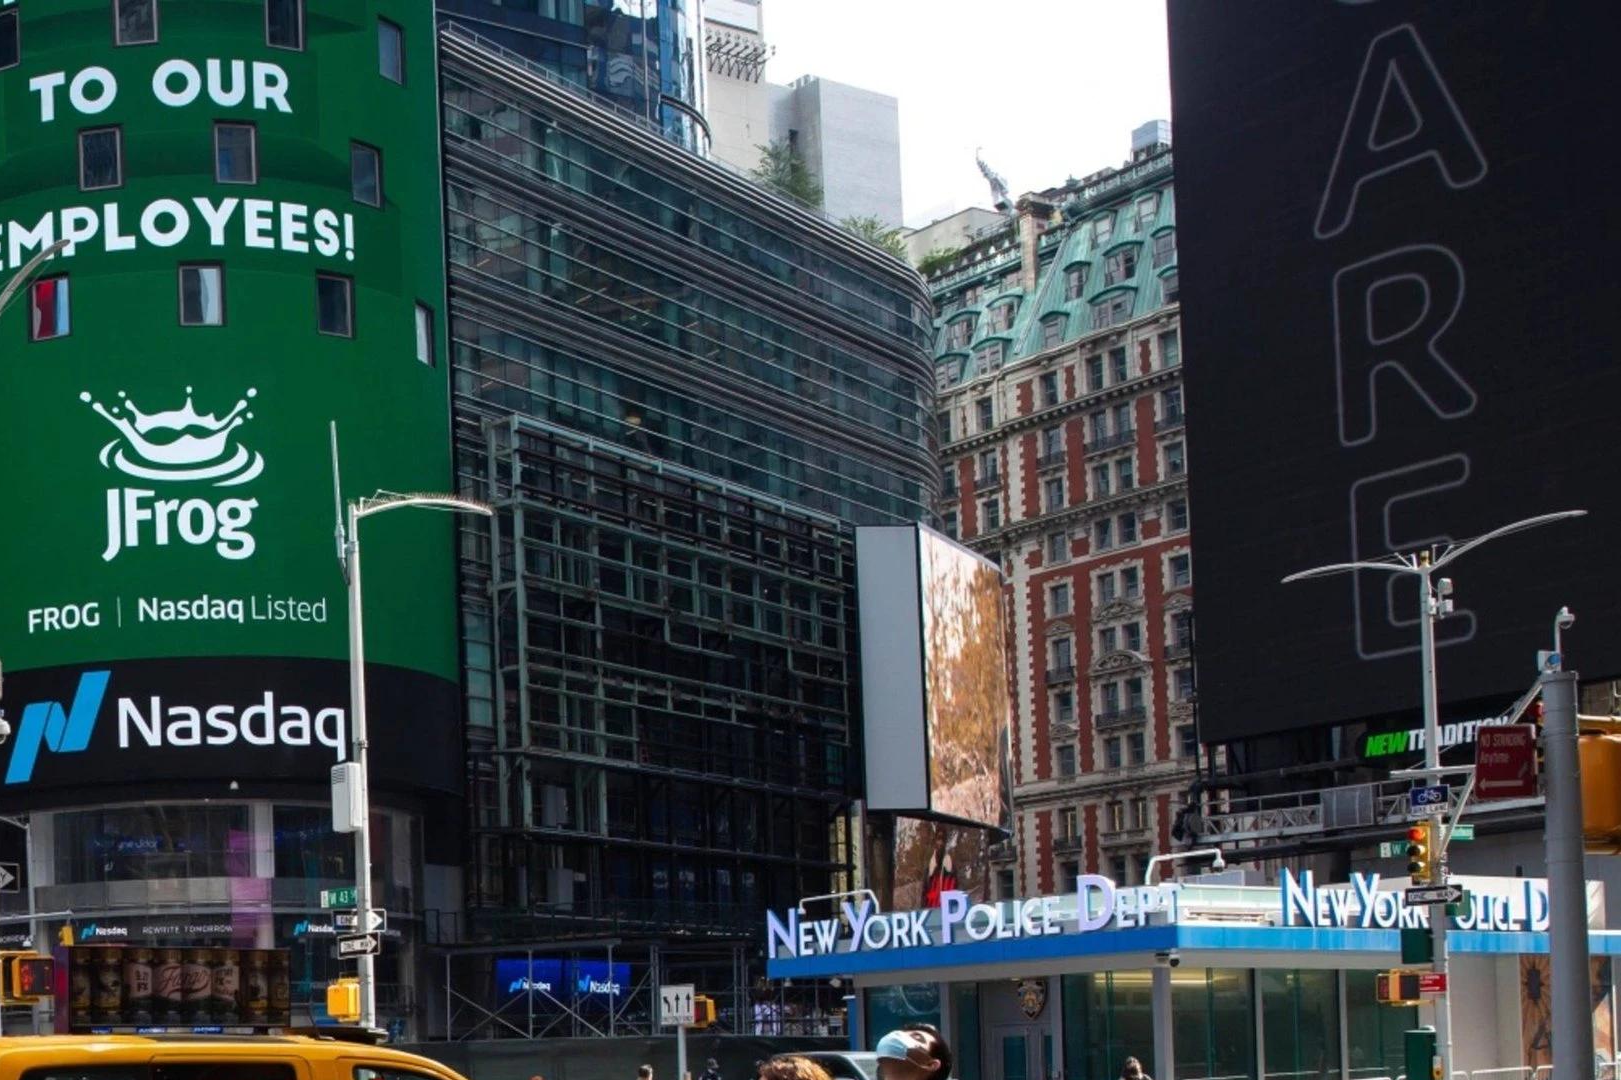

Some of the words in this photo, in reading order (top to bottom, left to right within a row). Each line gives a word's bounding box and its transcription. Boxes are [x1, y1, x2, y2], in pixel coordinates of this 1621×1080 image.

[30, 66, 118, 122] TO
[152, 58, 292, 114] OUR
[1314, 0, 1488, 660] ARE
[101, 487, 259, 562] JFrog
[28, 602, 101, 634] FROG
[138, 594, 245, 623] Nasdaq
[251, 595, 327, 623] Listed
[118, 691, 346, 763] Nasdaq
[96, 927, 128, 937] Nasdaq
[1456, 894, 1523, 932] OLICE
[522, 981, 551, 992] Nsdaq
